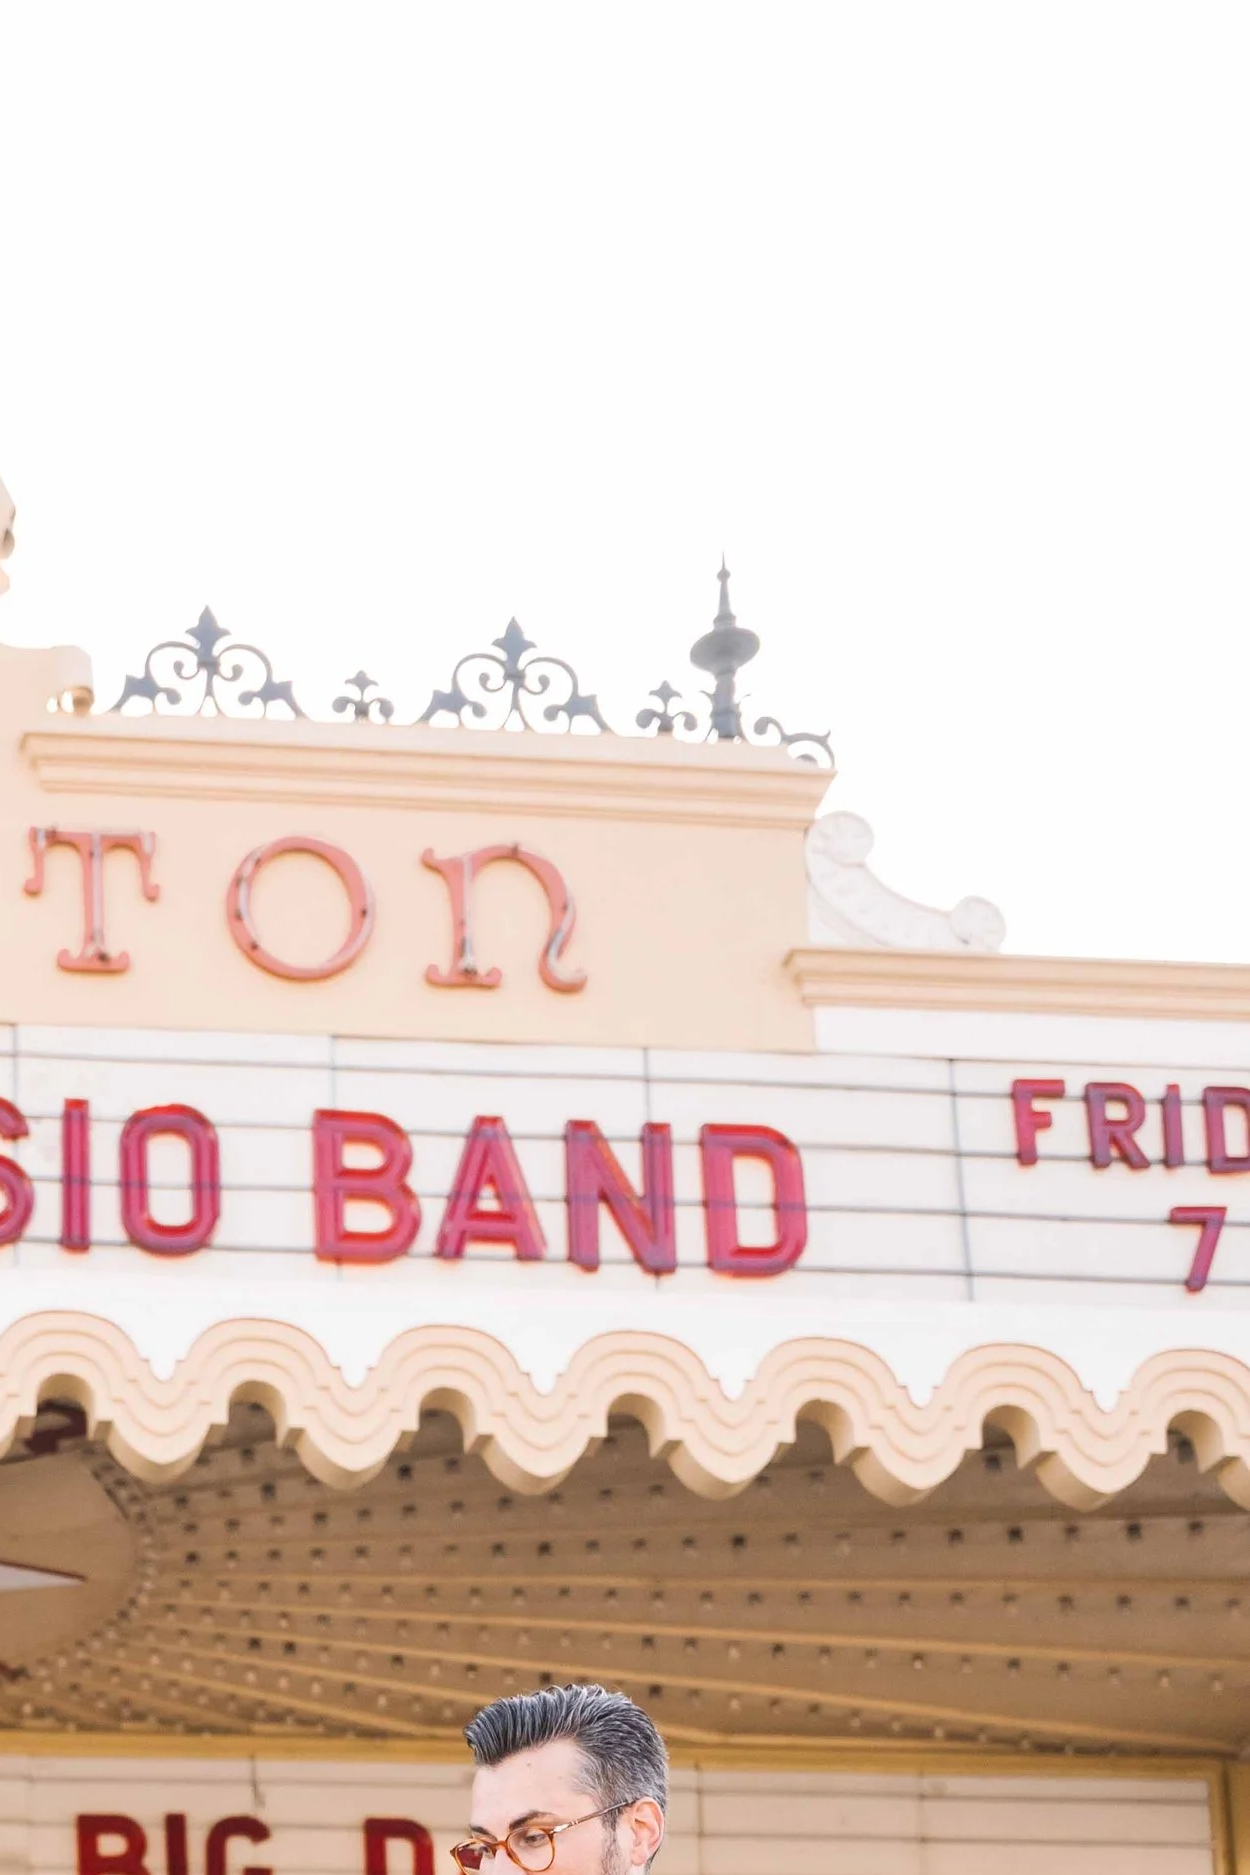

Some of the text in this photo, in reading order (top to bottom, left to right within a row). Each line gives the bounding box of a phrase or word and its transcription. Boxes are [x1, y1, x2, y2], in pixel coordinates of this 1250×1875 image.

[1012, 1079, 1250, 1175] FRID
[312, 1109, 808, 1278] BAND
[1170, 1206, 1228, 1292] 7
